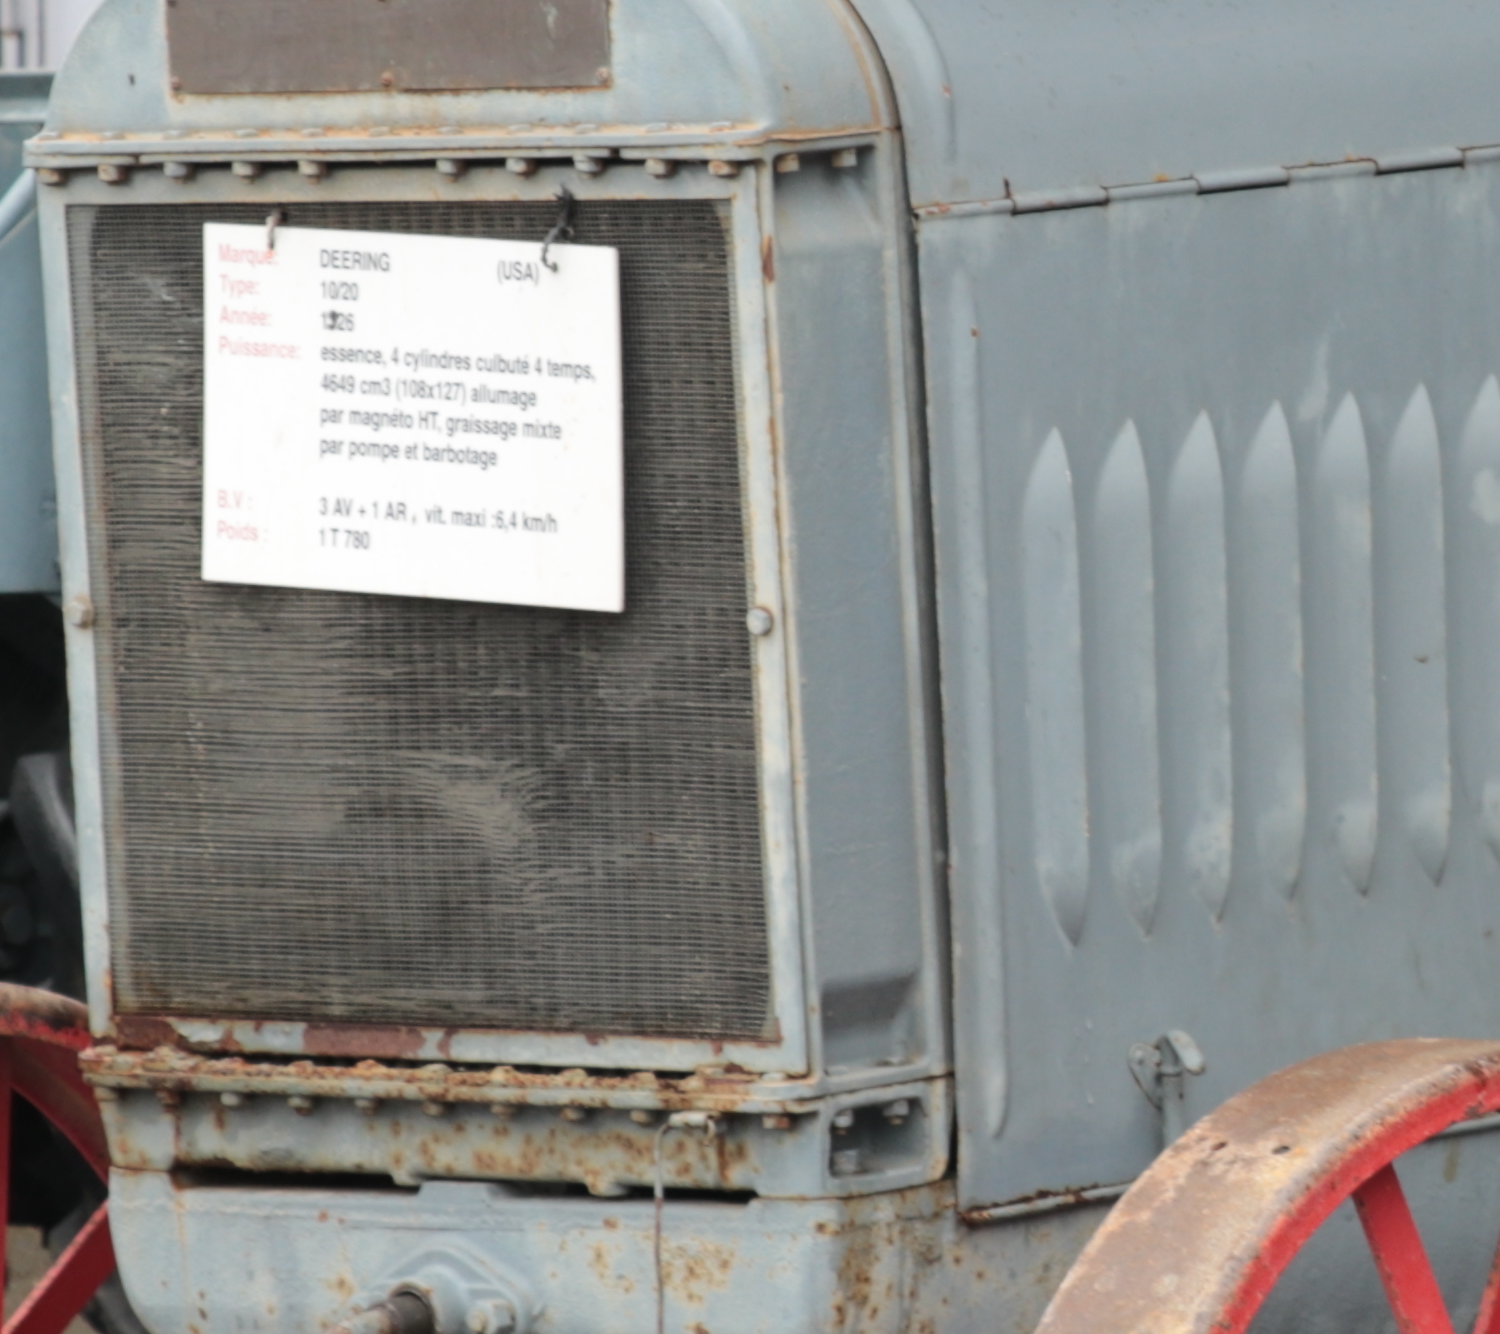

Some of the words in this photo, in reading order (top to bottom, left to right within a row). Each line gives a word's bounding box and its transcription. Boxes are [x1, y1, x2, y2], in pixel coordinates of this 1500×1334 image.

[218, 243, 279, 267] Marque:
[320, 249, 390, 272] DEERING
[497, 260, 540, 287] (USA)
[219, 275, 260, 299] Type:
[320, 281, 359, 302] 10/20
[219, 306, 272, 327] Année:
[218, 337, 301, 359] Puissance:
[320, 346, 387, 369] essence,
[390, 347, 399, 365] 4
[404, 348, 471, 372] cylindres
[475, 353, 530, 375] culbuté
[534, 357, 543, 374] 4
[547, 358, 596, 383] temps,
[321, 373, 356, 394] 4649
[360, 377, 390, 397] cm3
[396, 377, 466, 406] (108x127)
[471, 383, 537, 411] allumage
[320, 408, 344, 427] par
[349, 408, 413, 431] magnéto
[418, 410, 442, 435] HT,
[446, 414, 517, 441] graissage
[522, 418, 562, 439] mixte
[319, 439, 343, 459] par
[349, 441, 400, 461] pompe
[405, 445, 419, 460] et
[423, 445, 498, 471] barbotage
[319, 497, 328, 516] 3
[333, 497, 353, 518] AV
[372, 502, 379, 519] 1
[384, 502, 407, 521] AR
[451, 508, 486, 527] maxi
[522, 512, 559, 534] km/h
[217, 521, 260, 543] Poids
[319, 529, 326, 546] 1
[329, 529, 340, 547] T
[345, 530, 371, 550] 780
